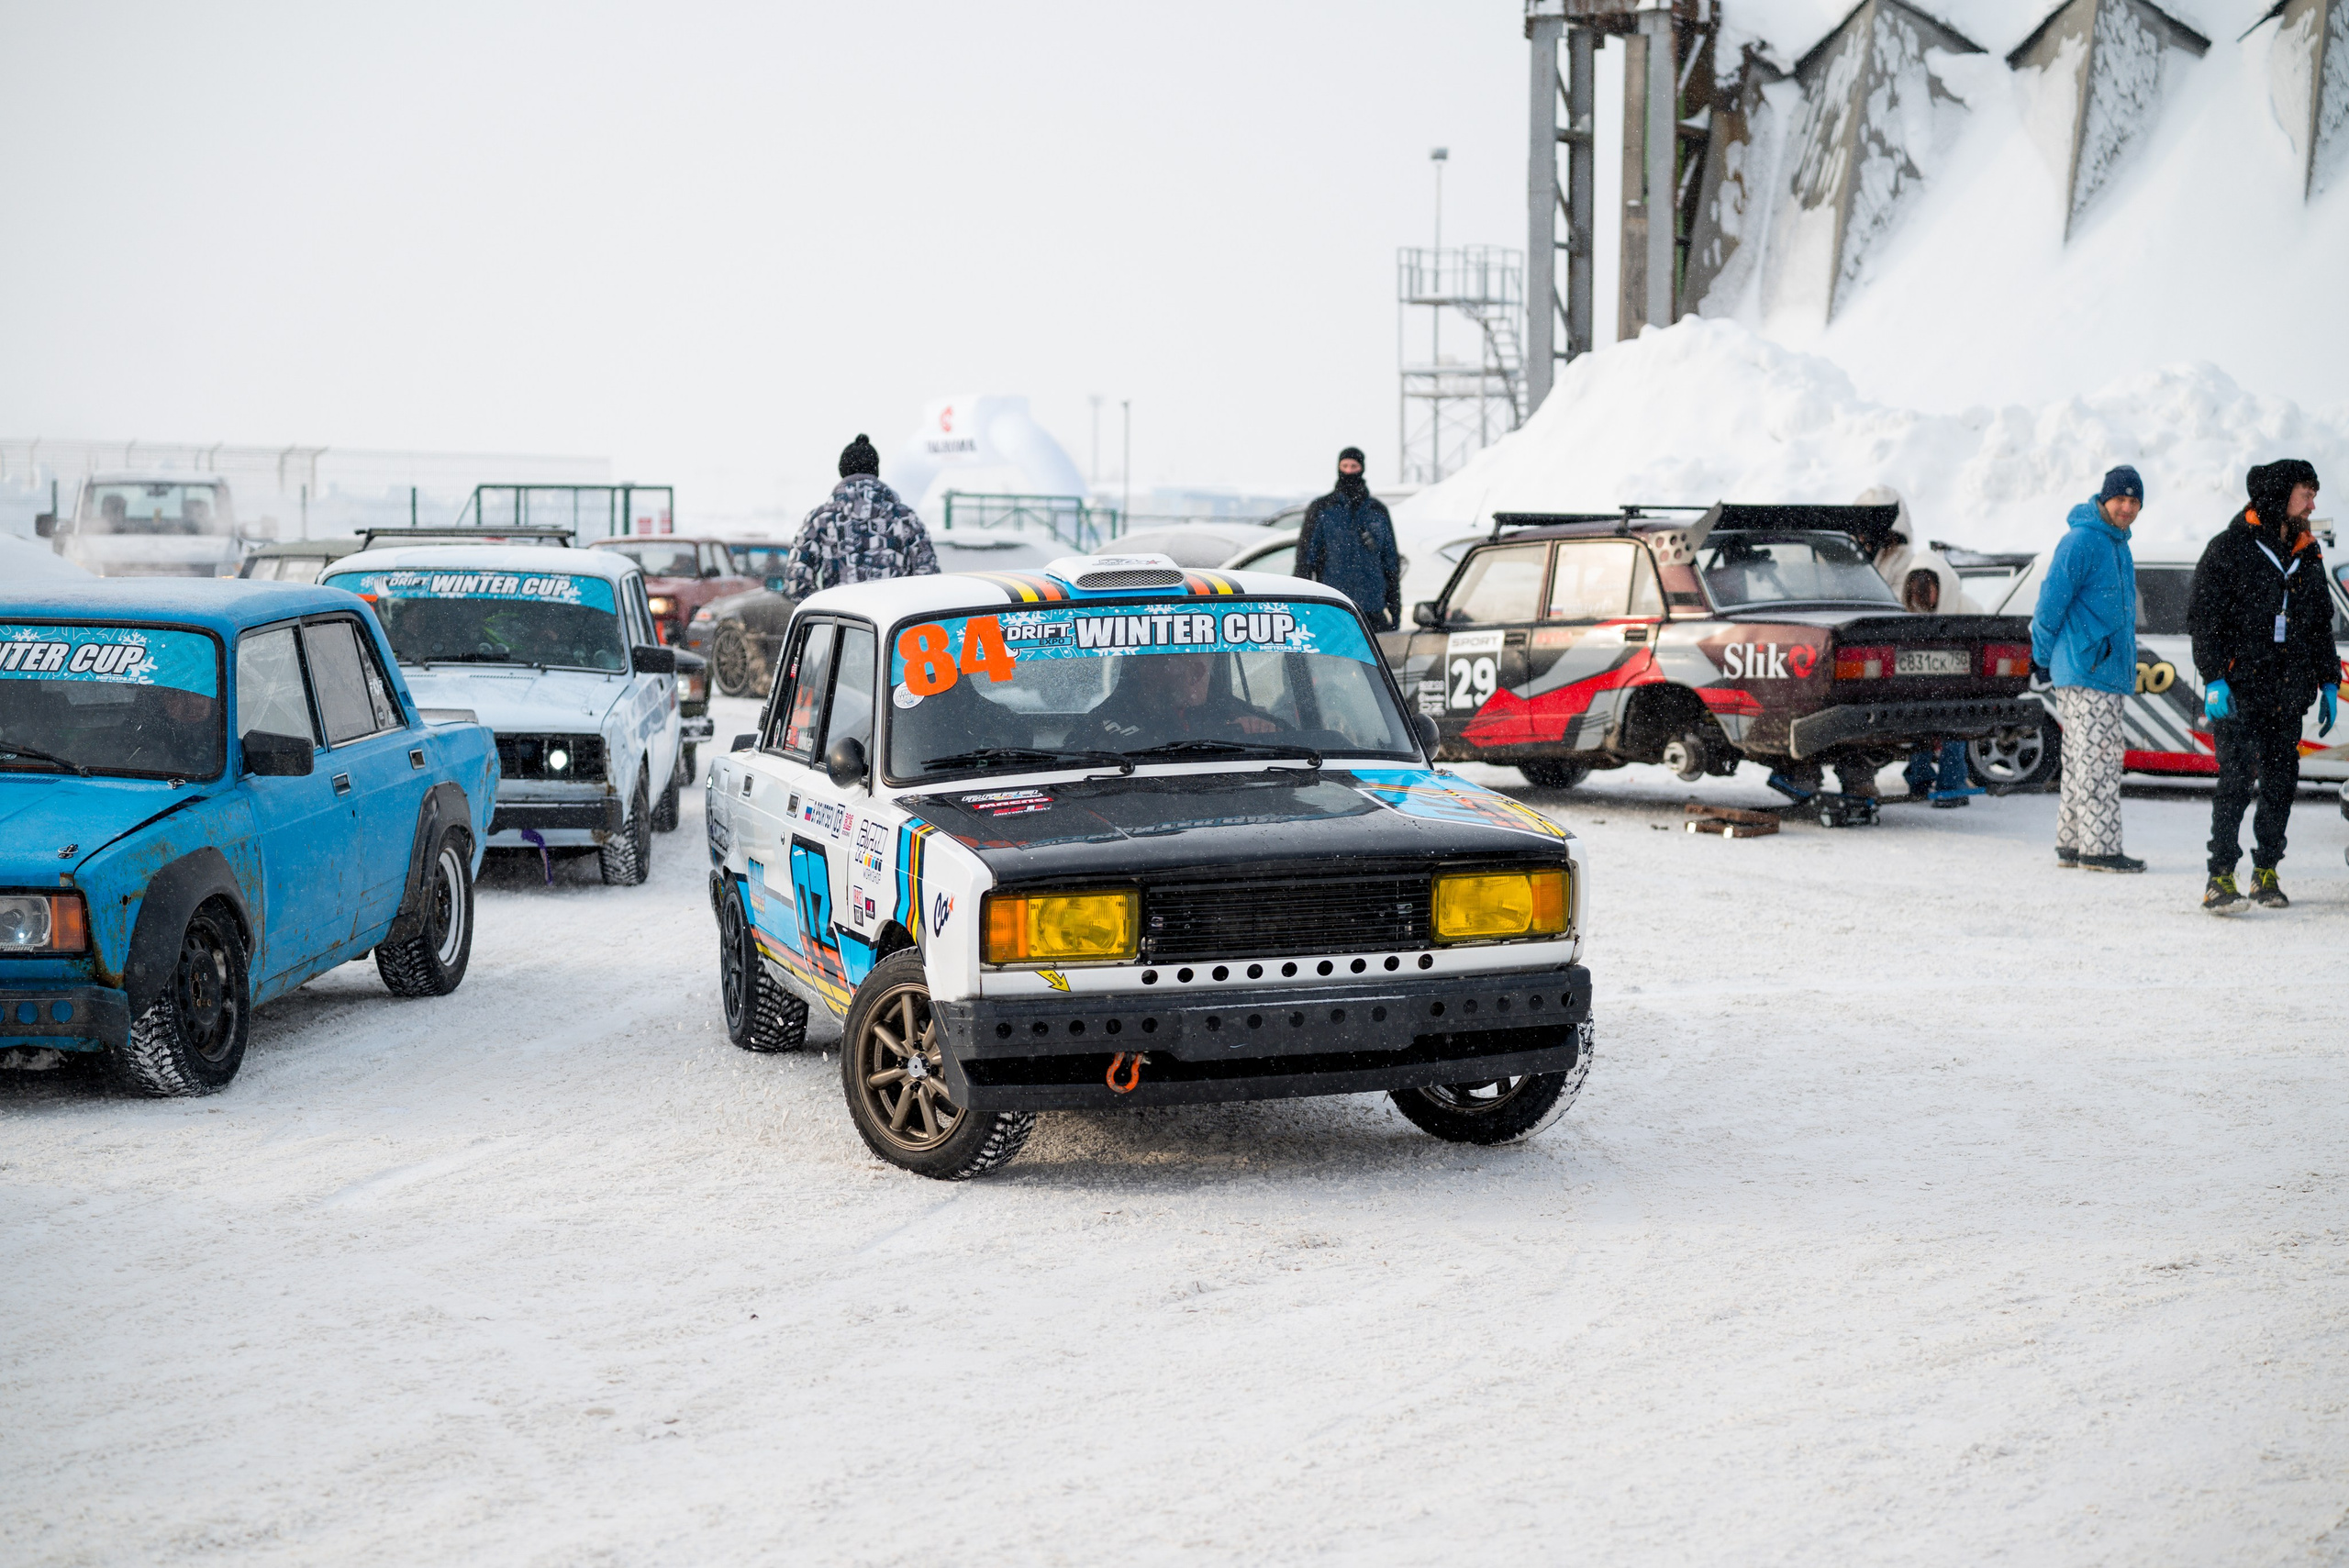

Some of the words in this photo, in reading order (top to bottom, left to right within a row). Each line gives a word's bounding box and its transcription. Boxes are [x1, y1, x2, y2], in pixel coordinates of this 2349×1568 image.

[387, 576, 429, 586] DRIFT
[430, 574, 519, 595] WINTER
[520, 576, 571, 596] CUP
[1007, 623, 1072, 641] DRIFT
[1074, 613, 1216, 649] WINTER
[1222, 612, 1296, 644] CUP
[1039, 638, 1065, 646] EXPO
[1452, 635, 1500, 647] SPORT
[68, 642, 146, 674] CUP
[897, 615, 1016, 696] 84
[1722, 641, 1789, 680] Slik
[1450, 656, 1497, 709] 29
